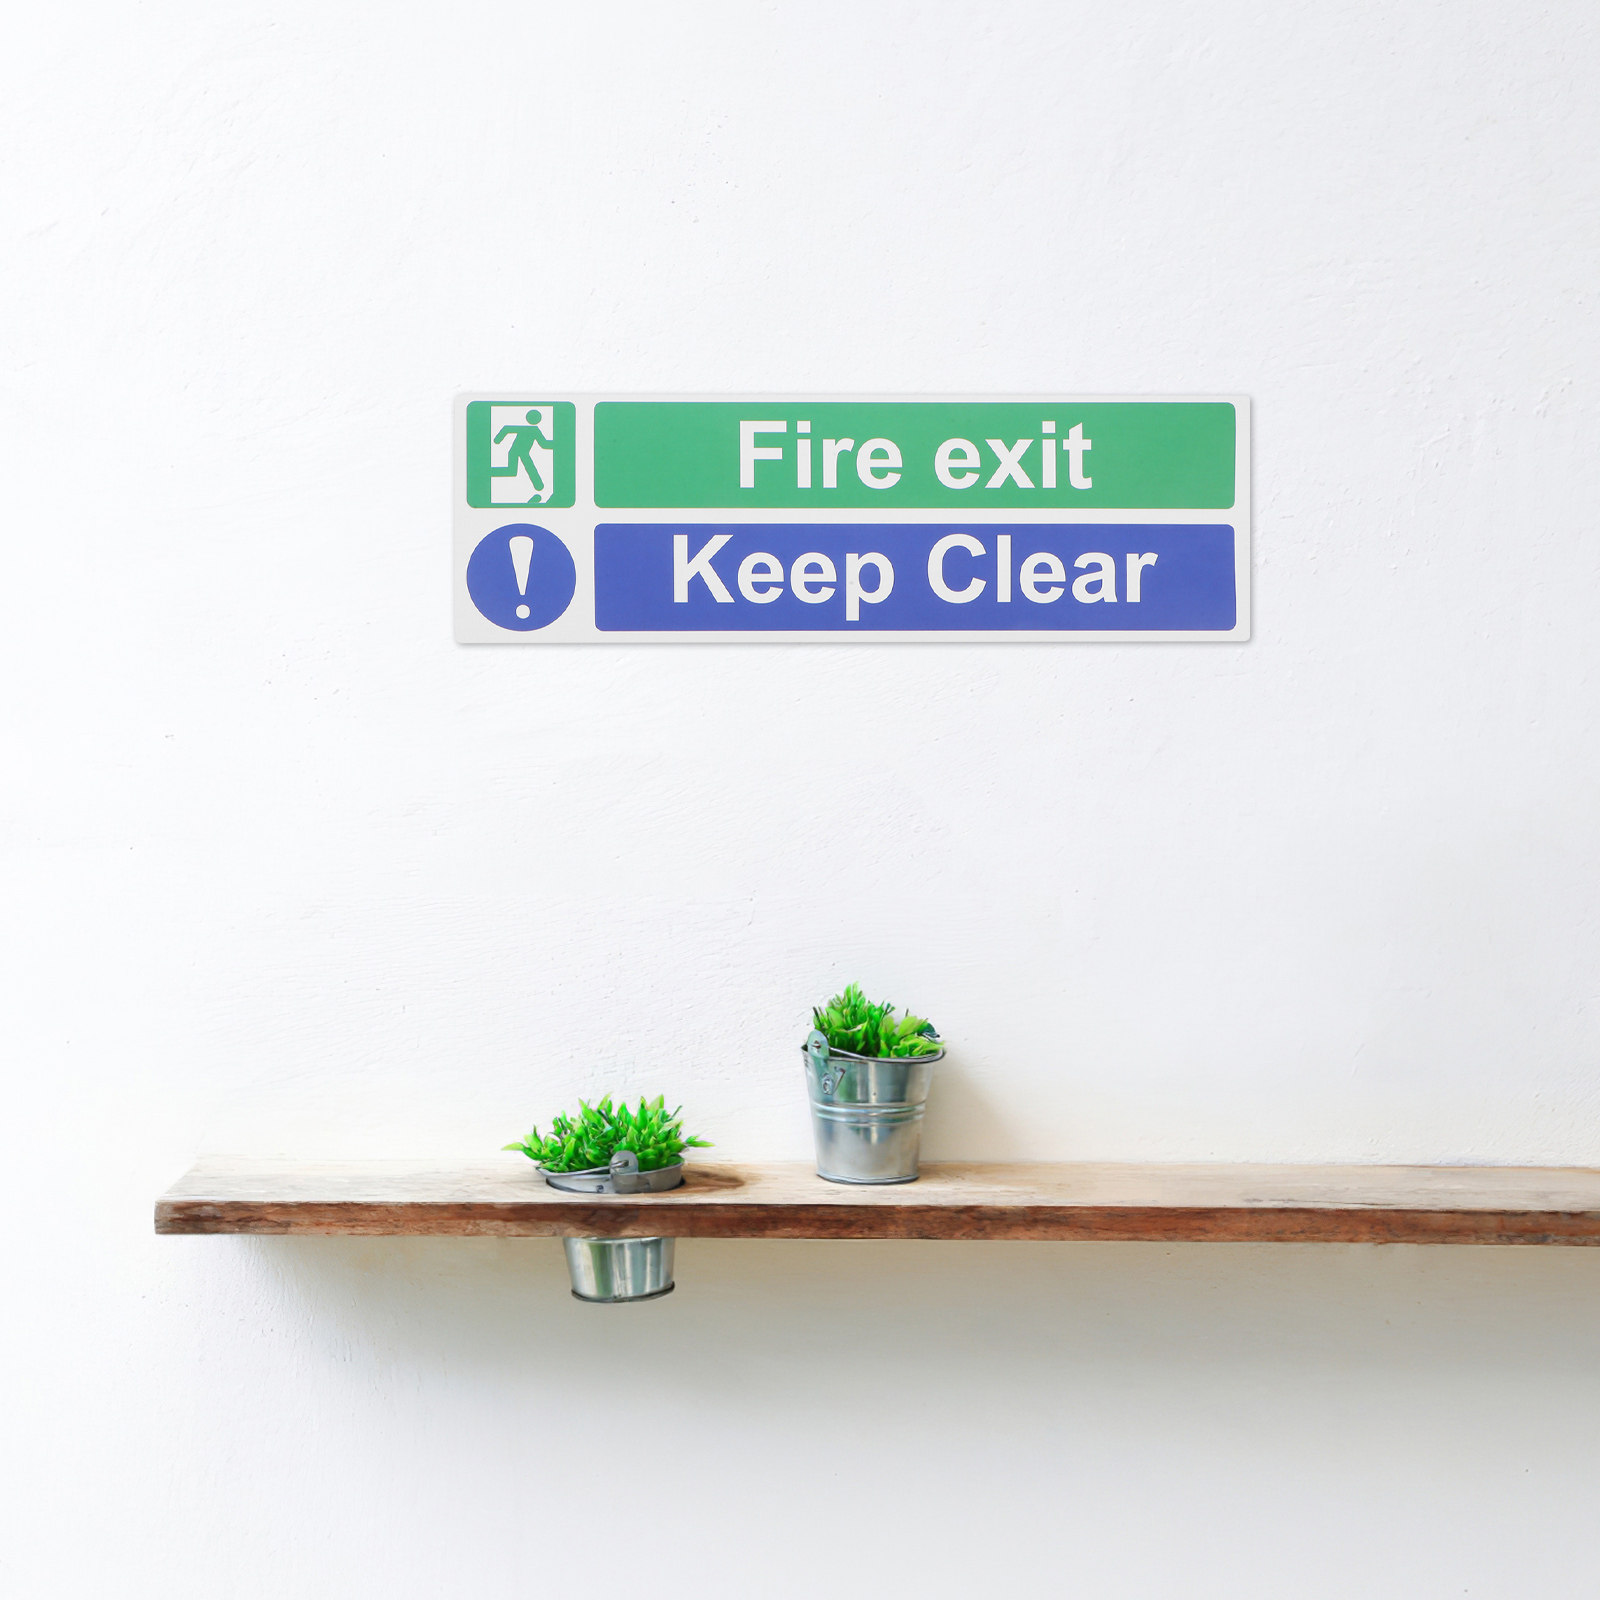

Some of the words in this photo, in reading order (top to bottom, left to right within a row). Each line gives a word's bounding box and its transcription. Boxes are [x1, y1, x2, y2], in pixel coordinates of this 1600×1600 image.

[738, 420, 903, 490] Fire
[934, 420, 1093, 490] exit
[673, 534, 895, 621] Keep
[927, 533, 1159, 604] Clear
